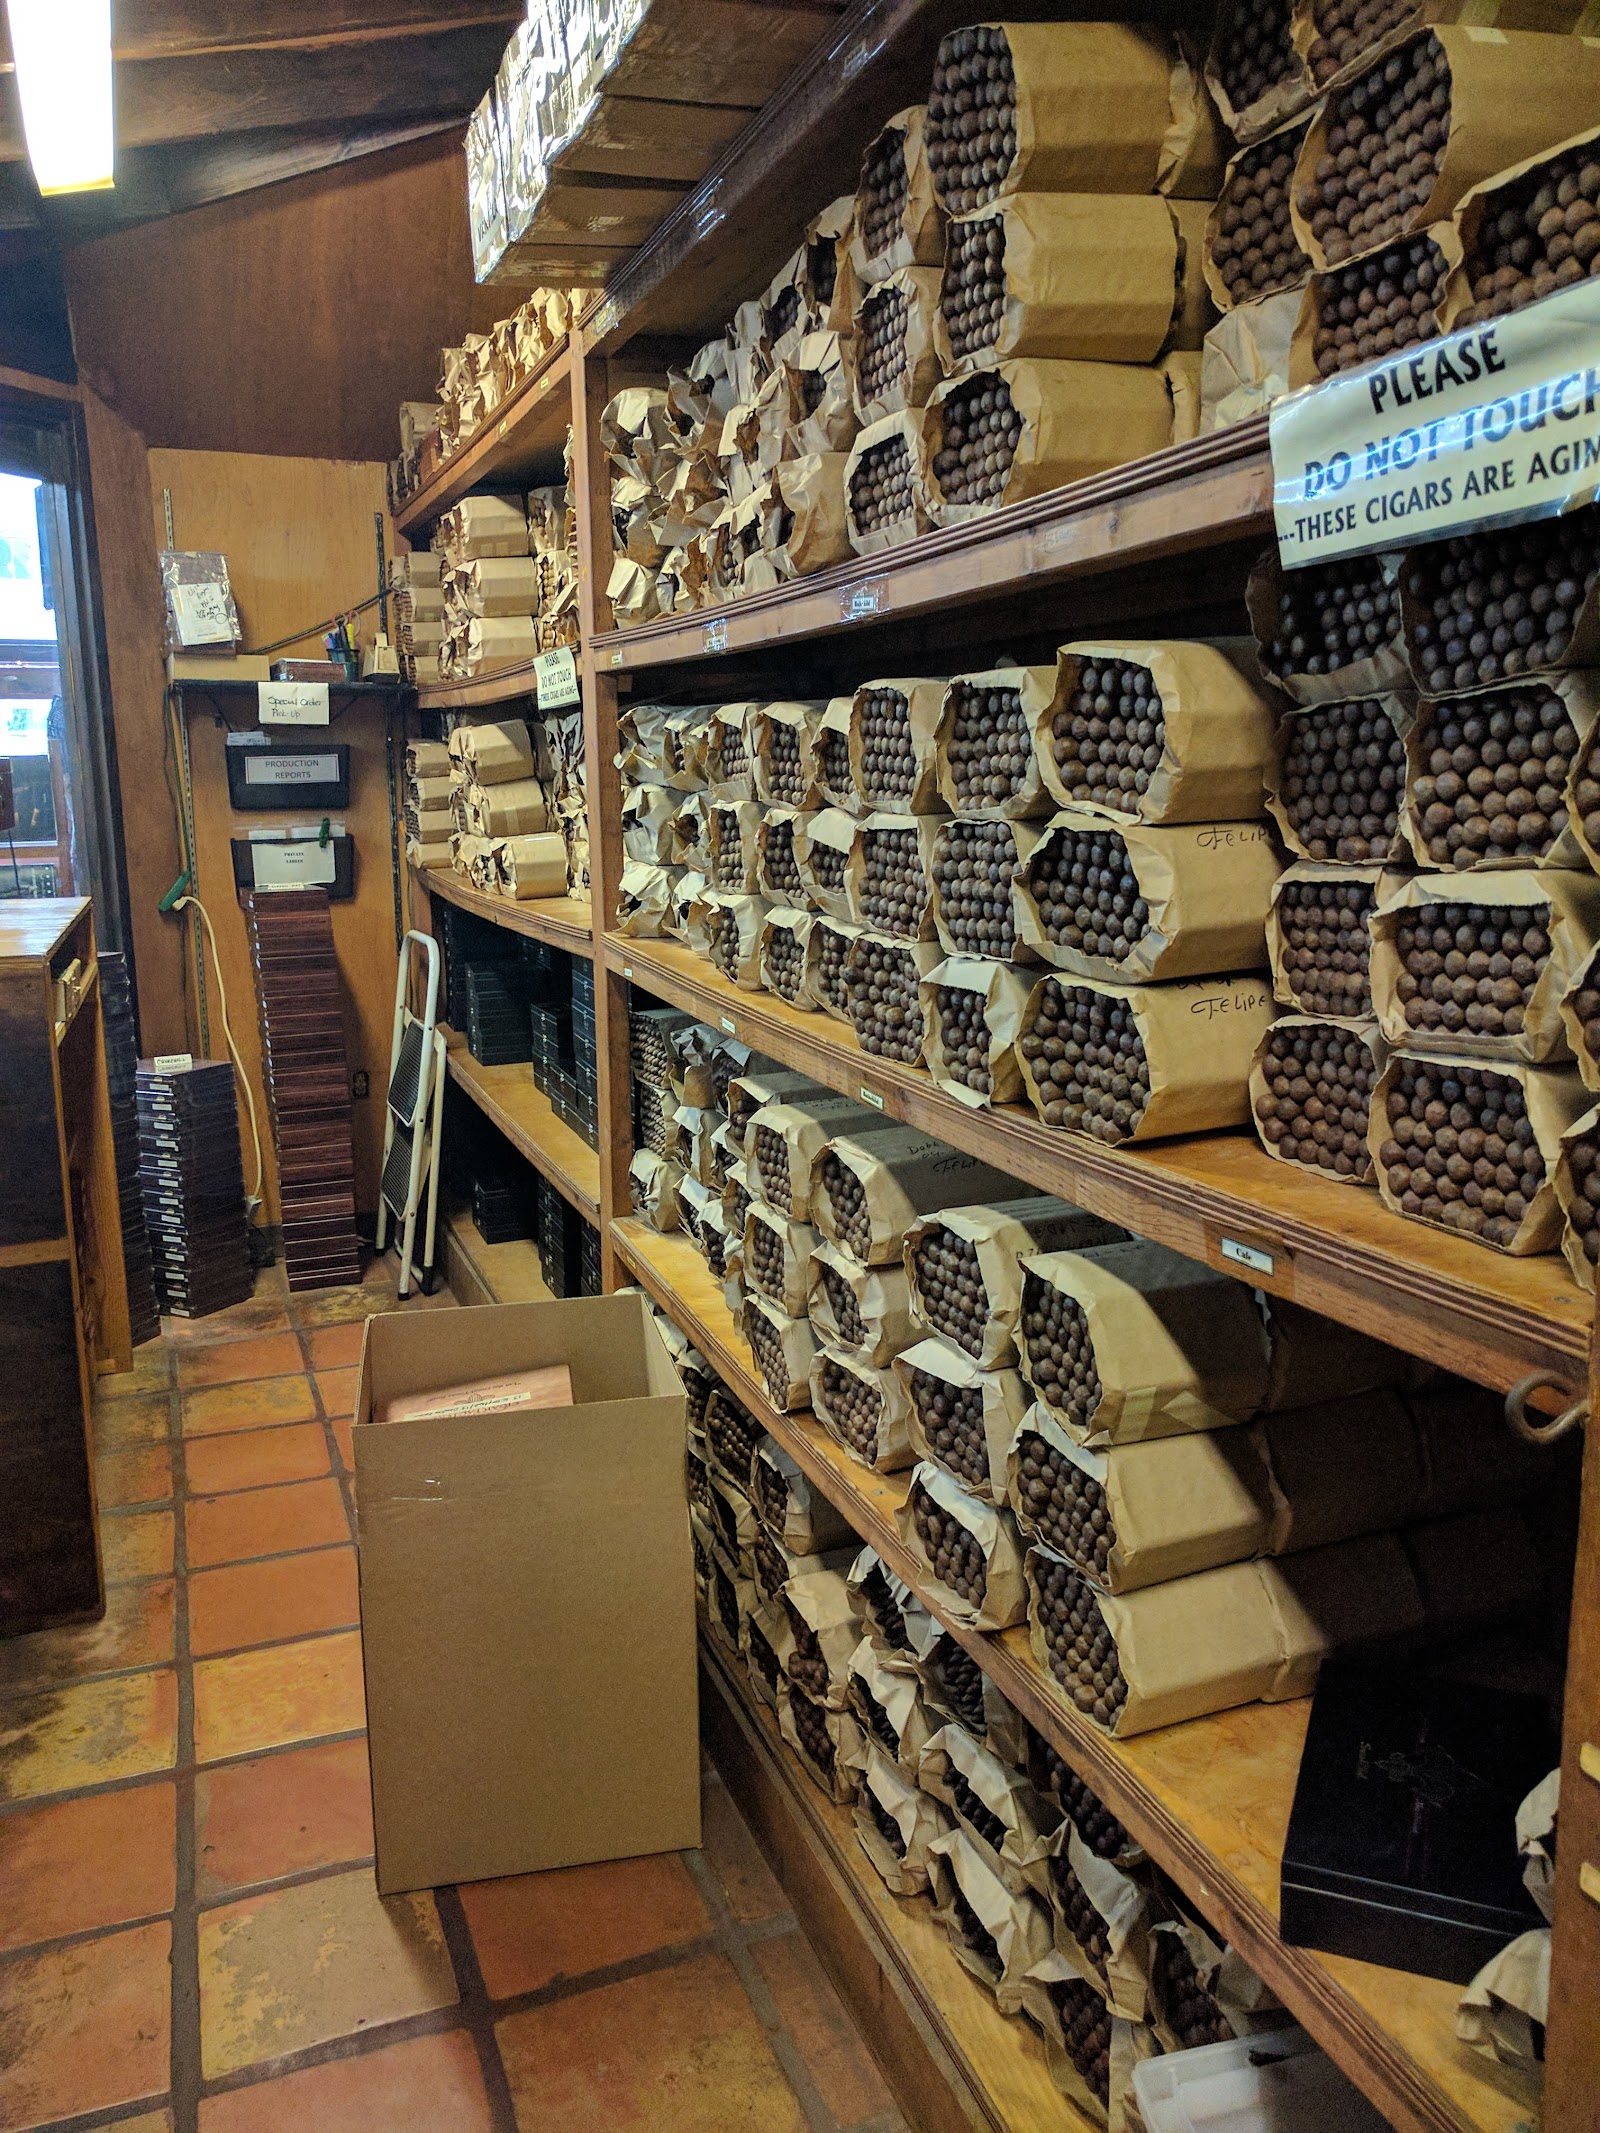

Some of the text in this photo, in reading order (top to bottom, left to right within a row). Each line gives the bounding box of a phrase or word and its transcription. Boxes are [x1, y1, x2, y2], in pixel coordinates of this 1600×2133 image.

[1368, 329, 1506, 415] PLEASE
[1304, 451, 1352, 501] DO
[1365, 417, 1446, 480] NOT
[1365, 477, 1452, 525] CIGARS
[1463, 459, 1516, 500] ARE
[544, 651, 560, 667] PLEASE
[268, 696, 298, 708] Special
[265, 759, 320, 768] PRODUCTION
[275, 771, 312, 779] REPORTS
